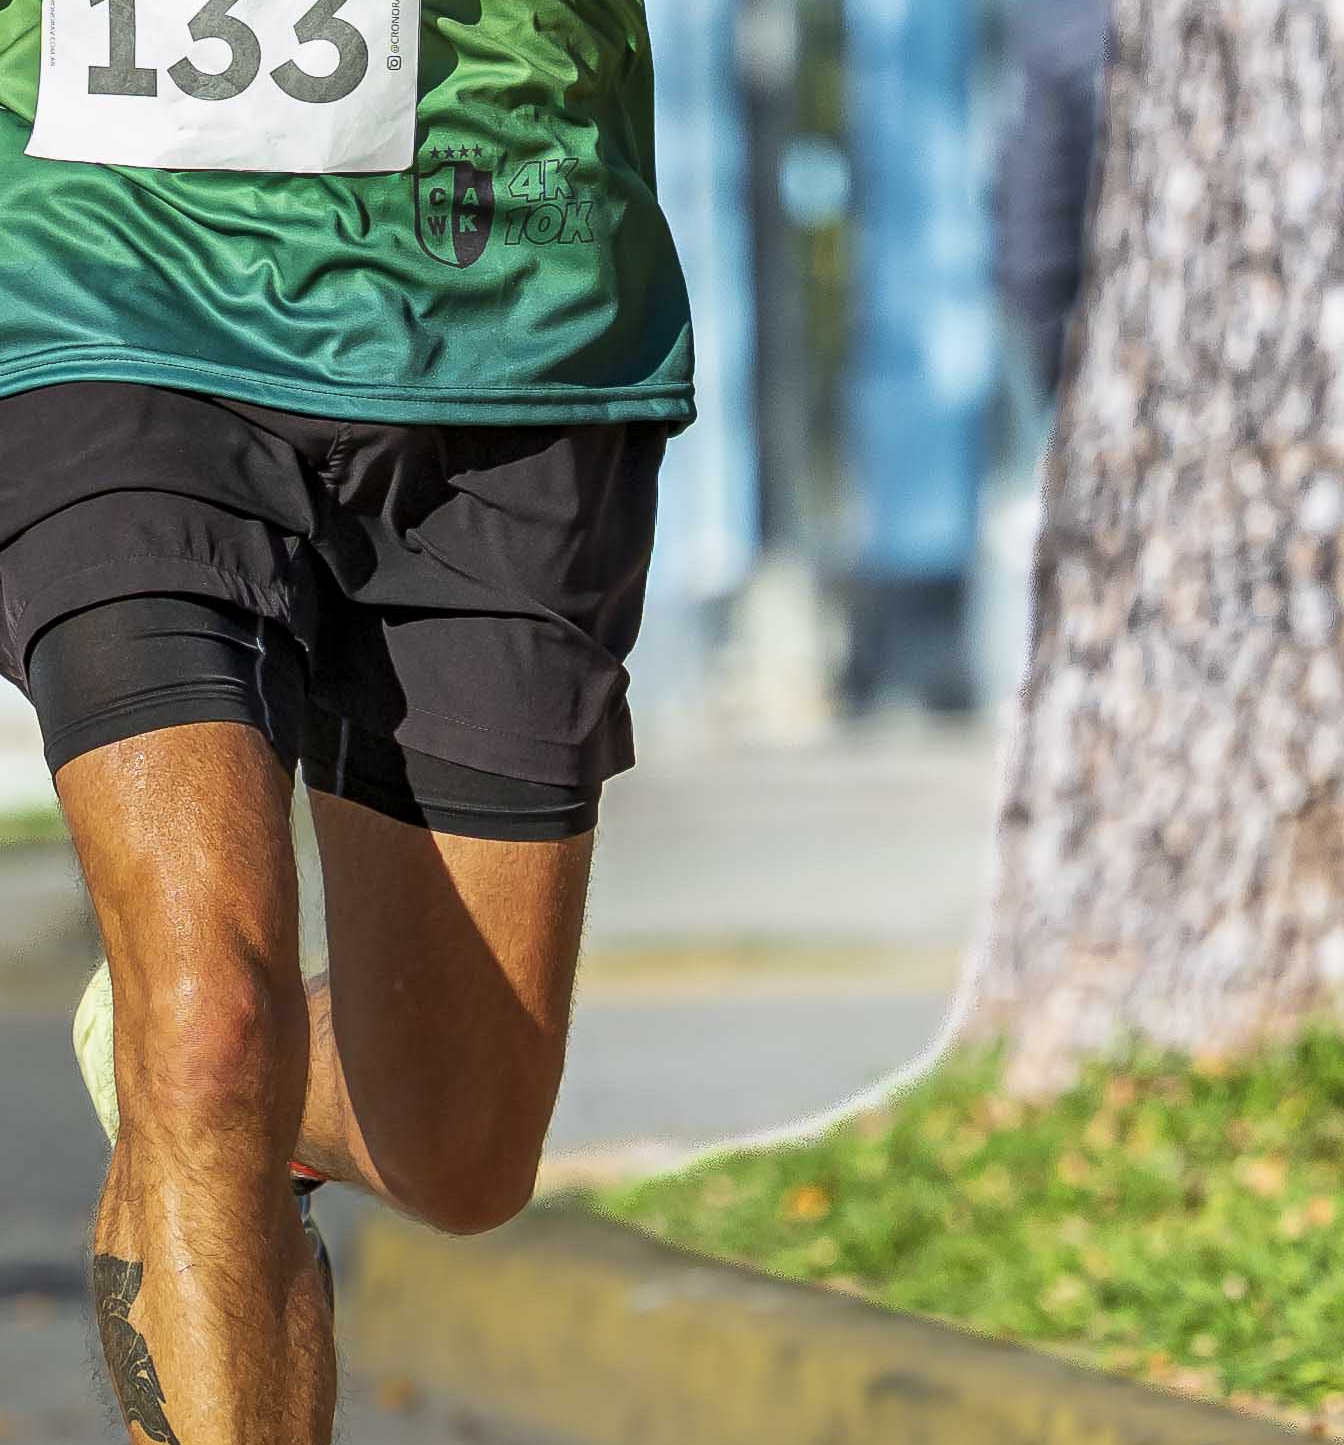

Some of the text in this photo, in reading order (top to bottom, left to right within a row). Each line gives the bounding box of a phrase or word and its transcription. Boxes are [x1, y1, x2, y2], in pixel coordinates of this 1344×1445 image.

[429, 187, 479, 206] C A
[508, 157, 579, 203] 4K
[427, 214, 478, 236] W K
[504, 201, 594, 246] 10K
